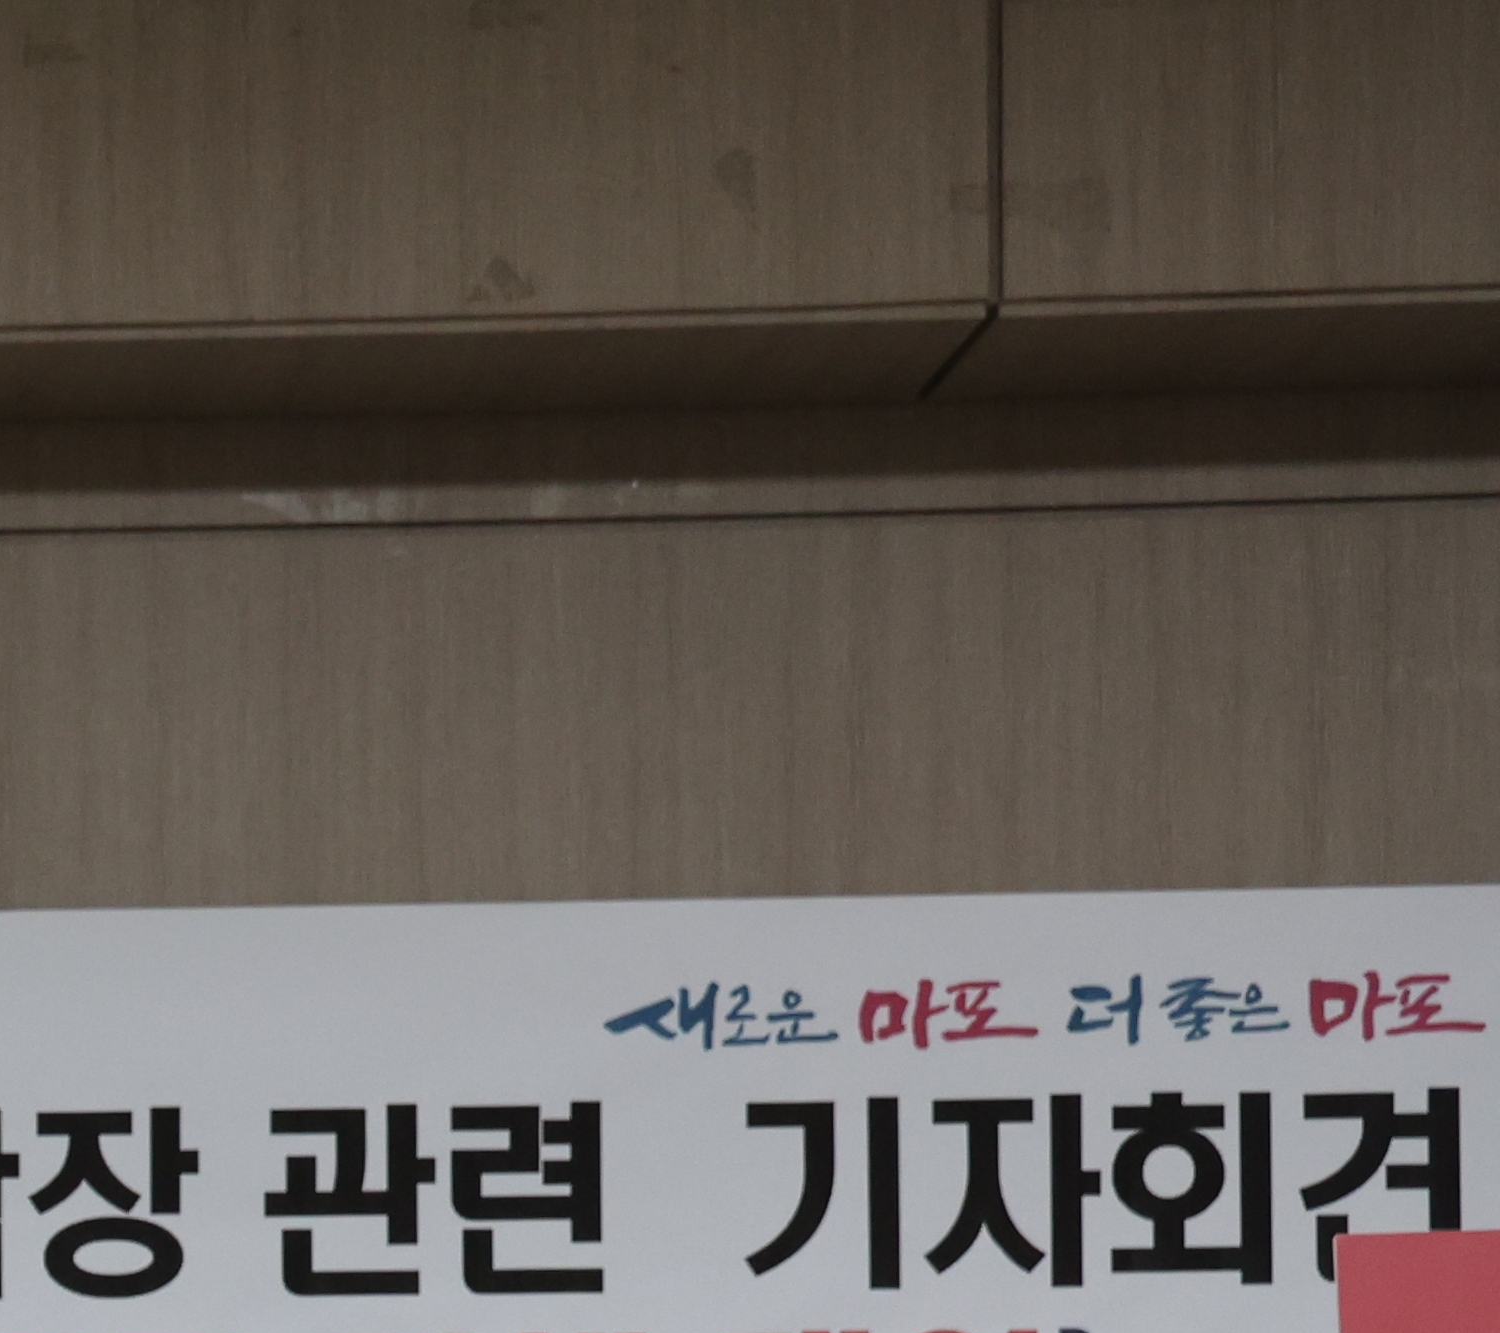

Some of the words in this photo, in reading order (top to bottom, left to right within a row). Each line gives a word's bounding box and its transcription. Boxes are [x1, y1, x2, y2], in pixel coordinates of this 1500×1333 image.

[604, 982, 839, 1051] 새로운
[859, 979, 1038, 1049] 마포
[1067, 975, 1142, 1045] 더
[1161, 978, 1290, 1041] 좋은
[1309, 971, 1486, 1041] 마포
[264, 1100, 604, 1297] 관련
[745, 1087, 1463, 1290] 기자회견
